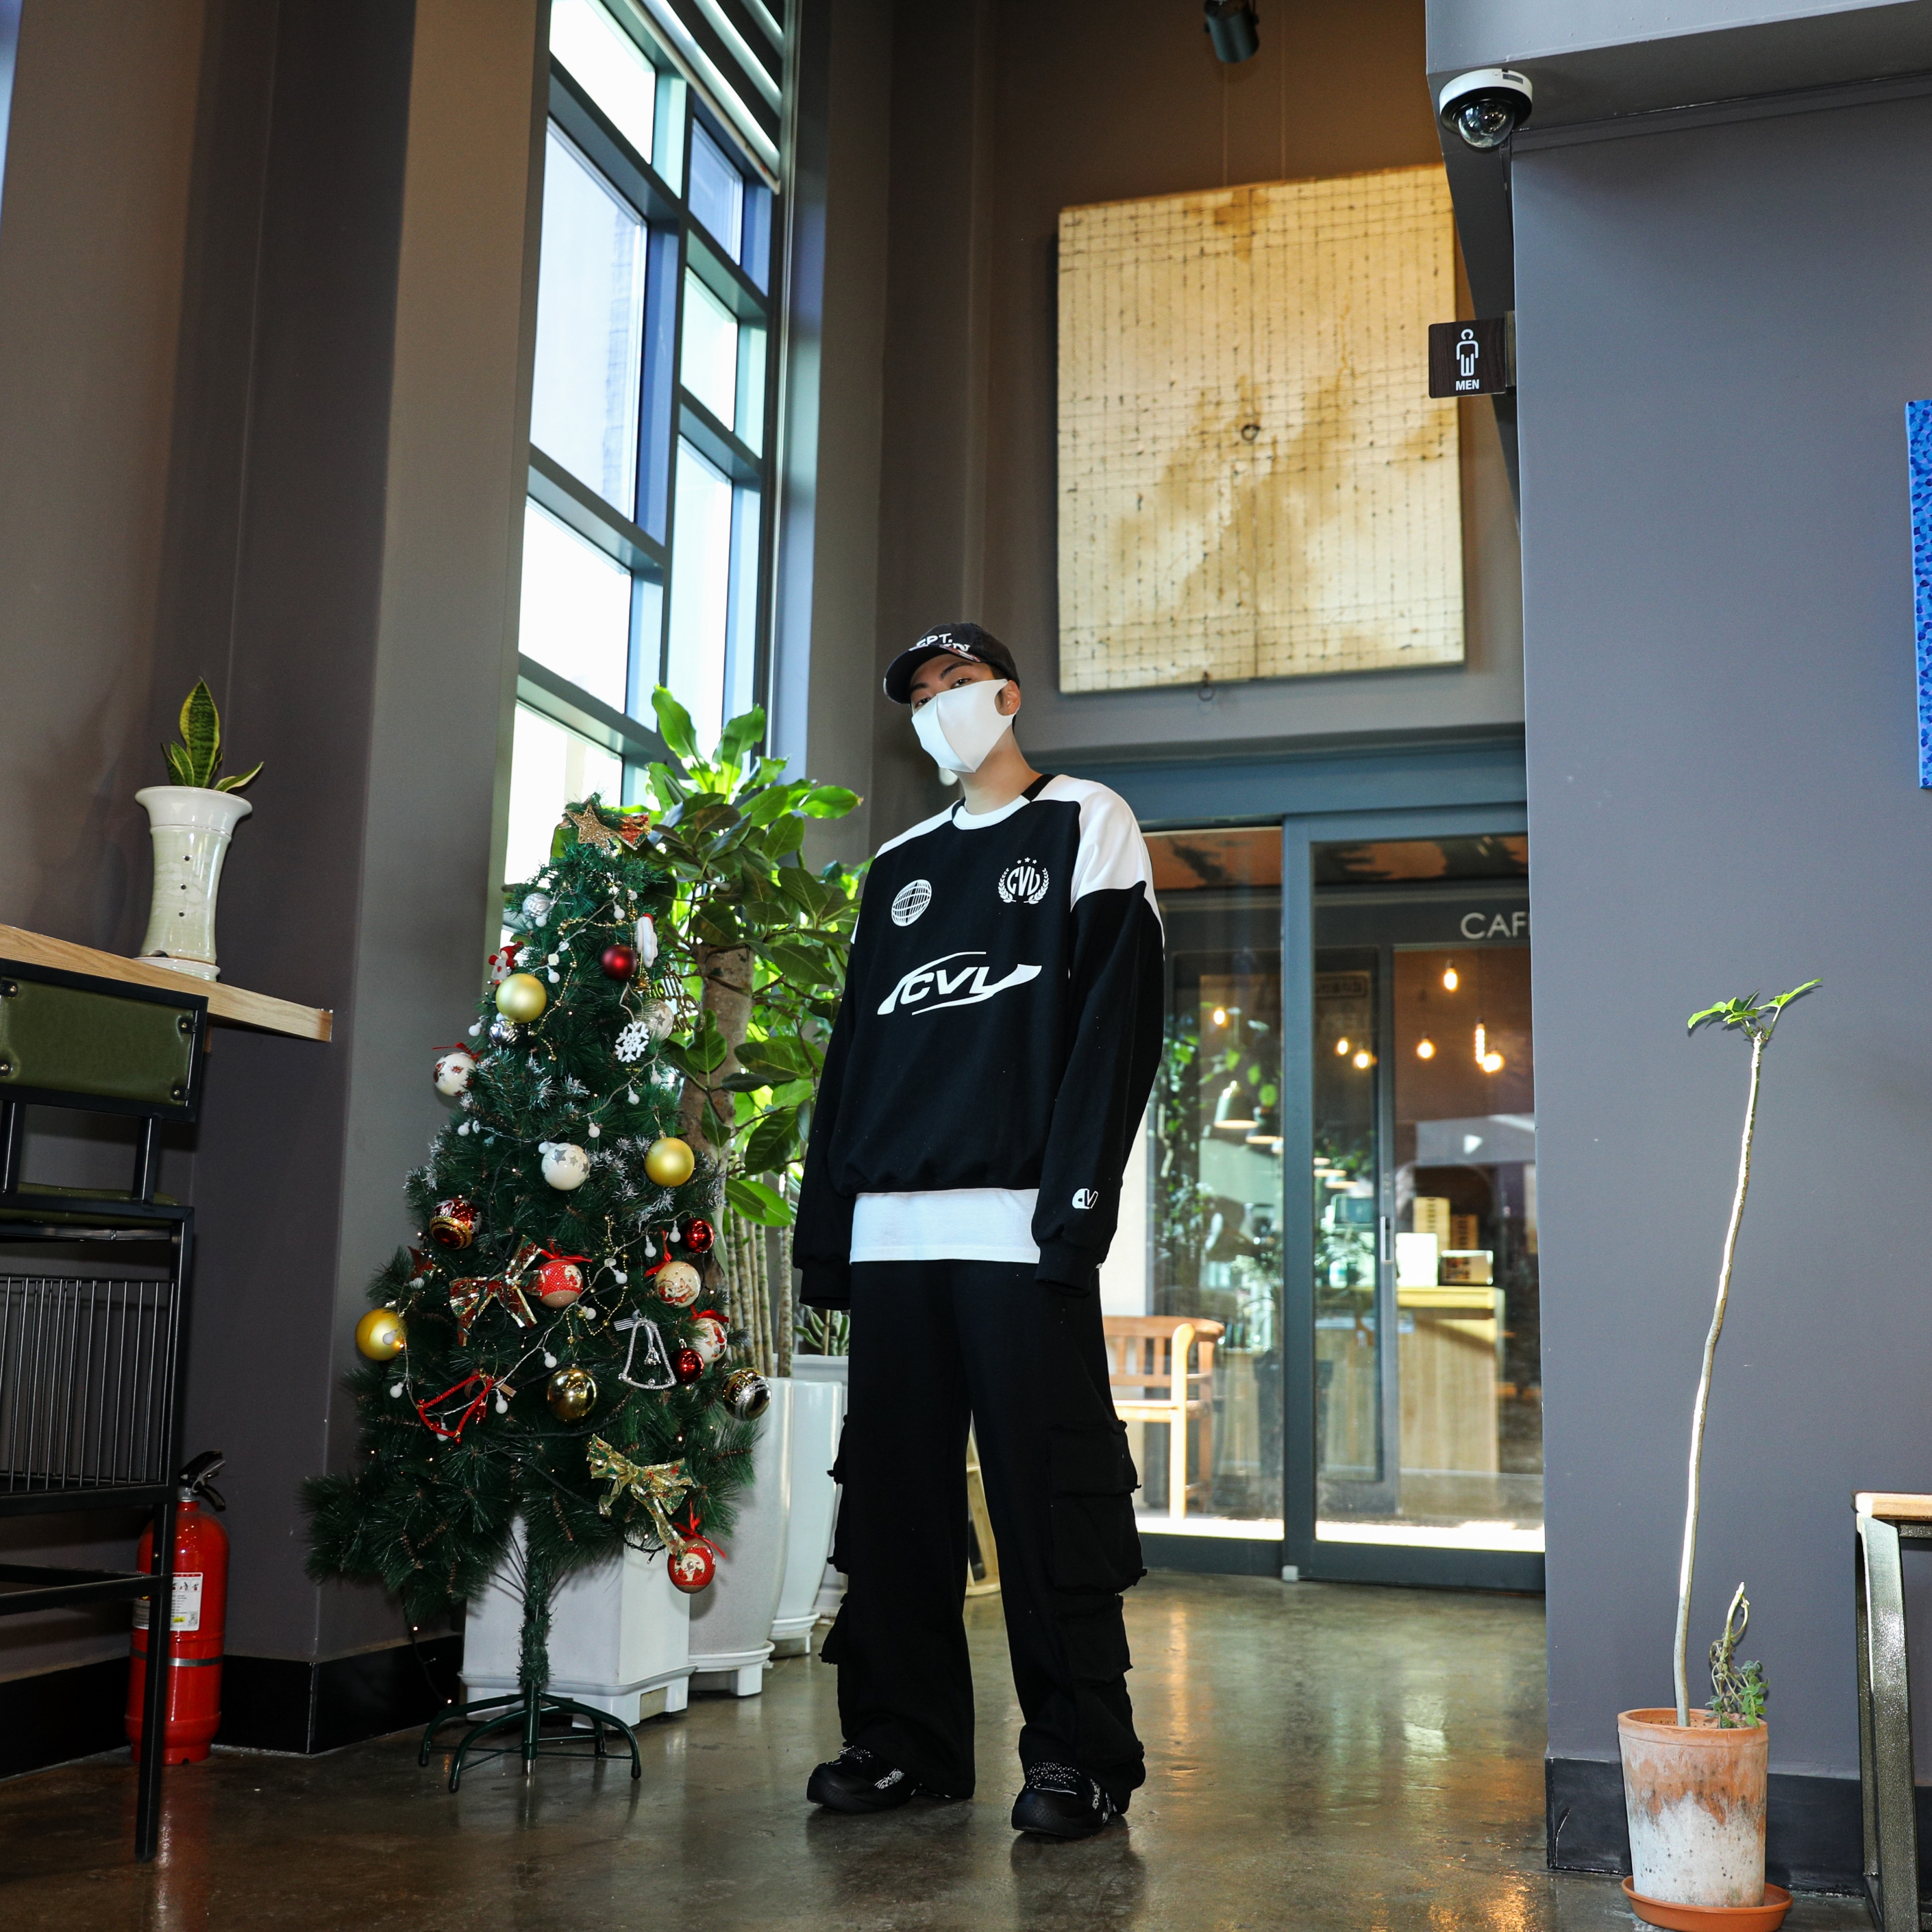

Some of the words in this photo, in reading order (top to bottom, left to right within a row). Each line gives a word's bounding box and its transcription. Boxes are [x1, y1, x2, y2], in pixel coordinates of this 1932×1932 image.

[1456, 379, 1480, 391] MEN
[1460, 912, 1531, 939] CAF
[900, 964, 1041, 1005] CVL
